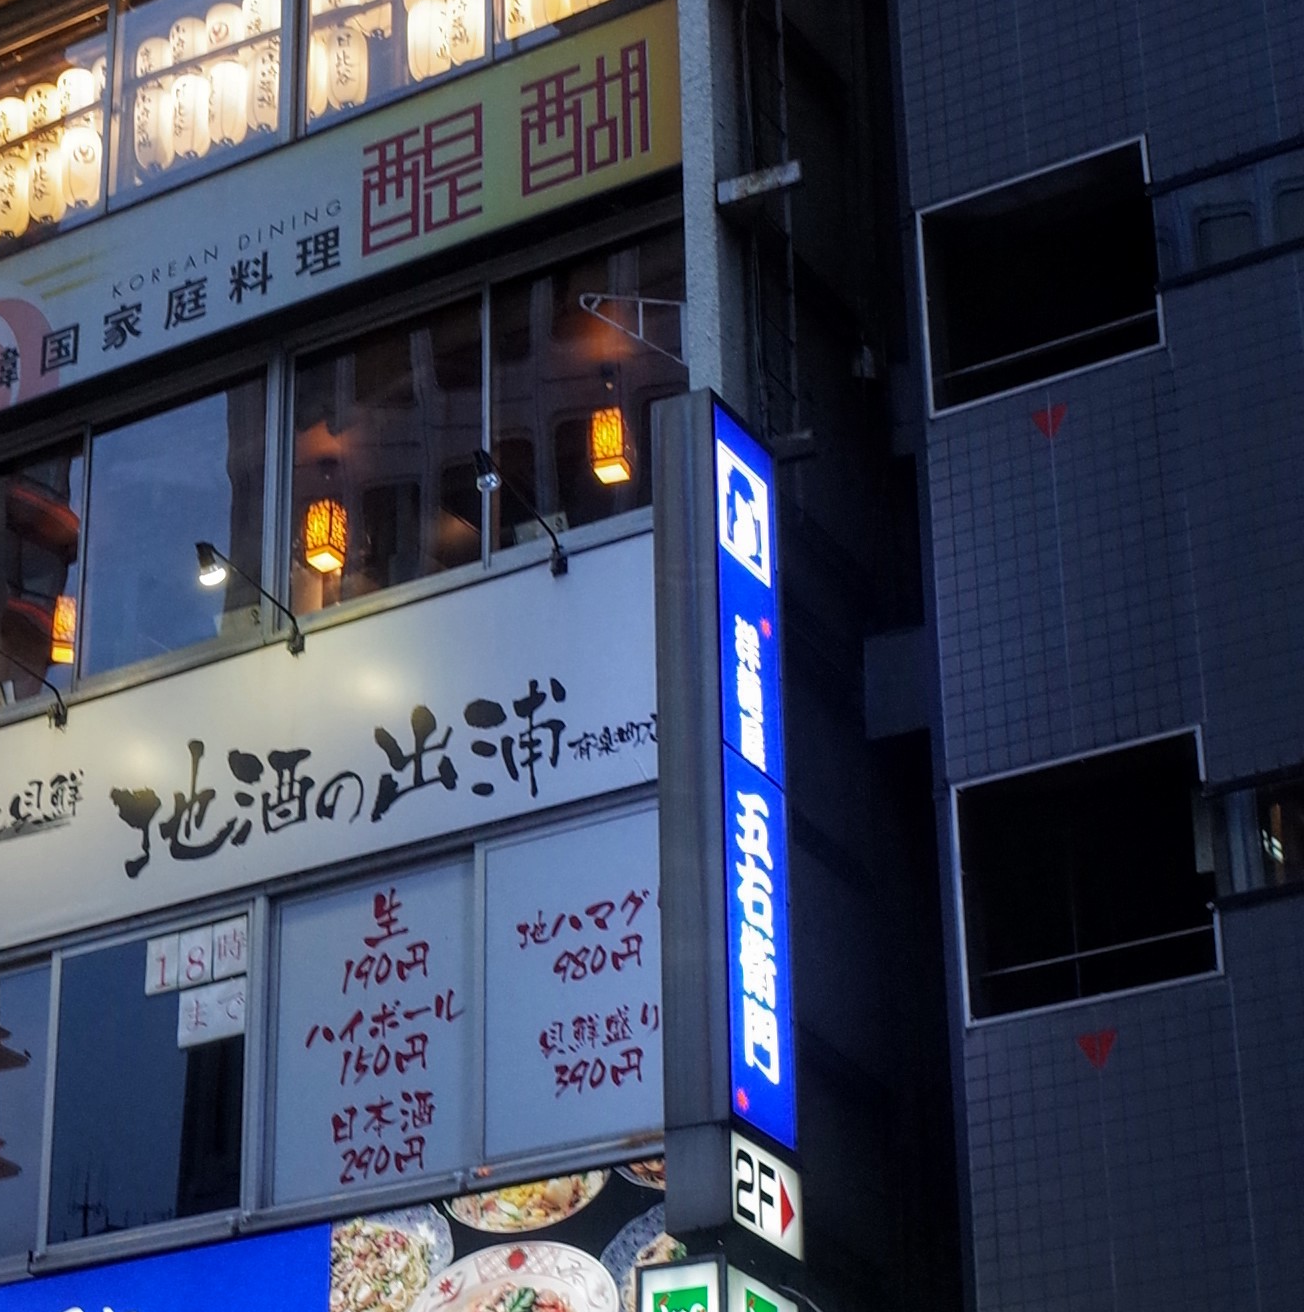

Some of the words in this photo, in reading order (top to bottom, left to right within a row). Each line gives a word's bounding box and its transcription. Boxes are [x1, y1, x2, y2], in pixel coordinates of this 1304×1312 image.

[362, 39, 651, 257] 醍醐
[112, 245, 218, 298] KOREAN
[237, 199, 342, 248] DINING
[364, 887, 409, 950] 生
[734, 789, 781, 1086] 五右衛門
[153, 929, 246, 991] 18時
[305, 989, 465, 1051] ハイボール
[340, 1033, 429, 1087] 150円
[331, 1089, 436, 1146] 日本酒
[339, 1135, 427, 1186] 290円
[734, 1147, 776, 1231] 2F
